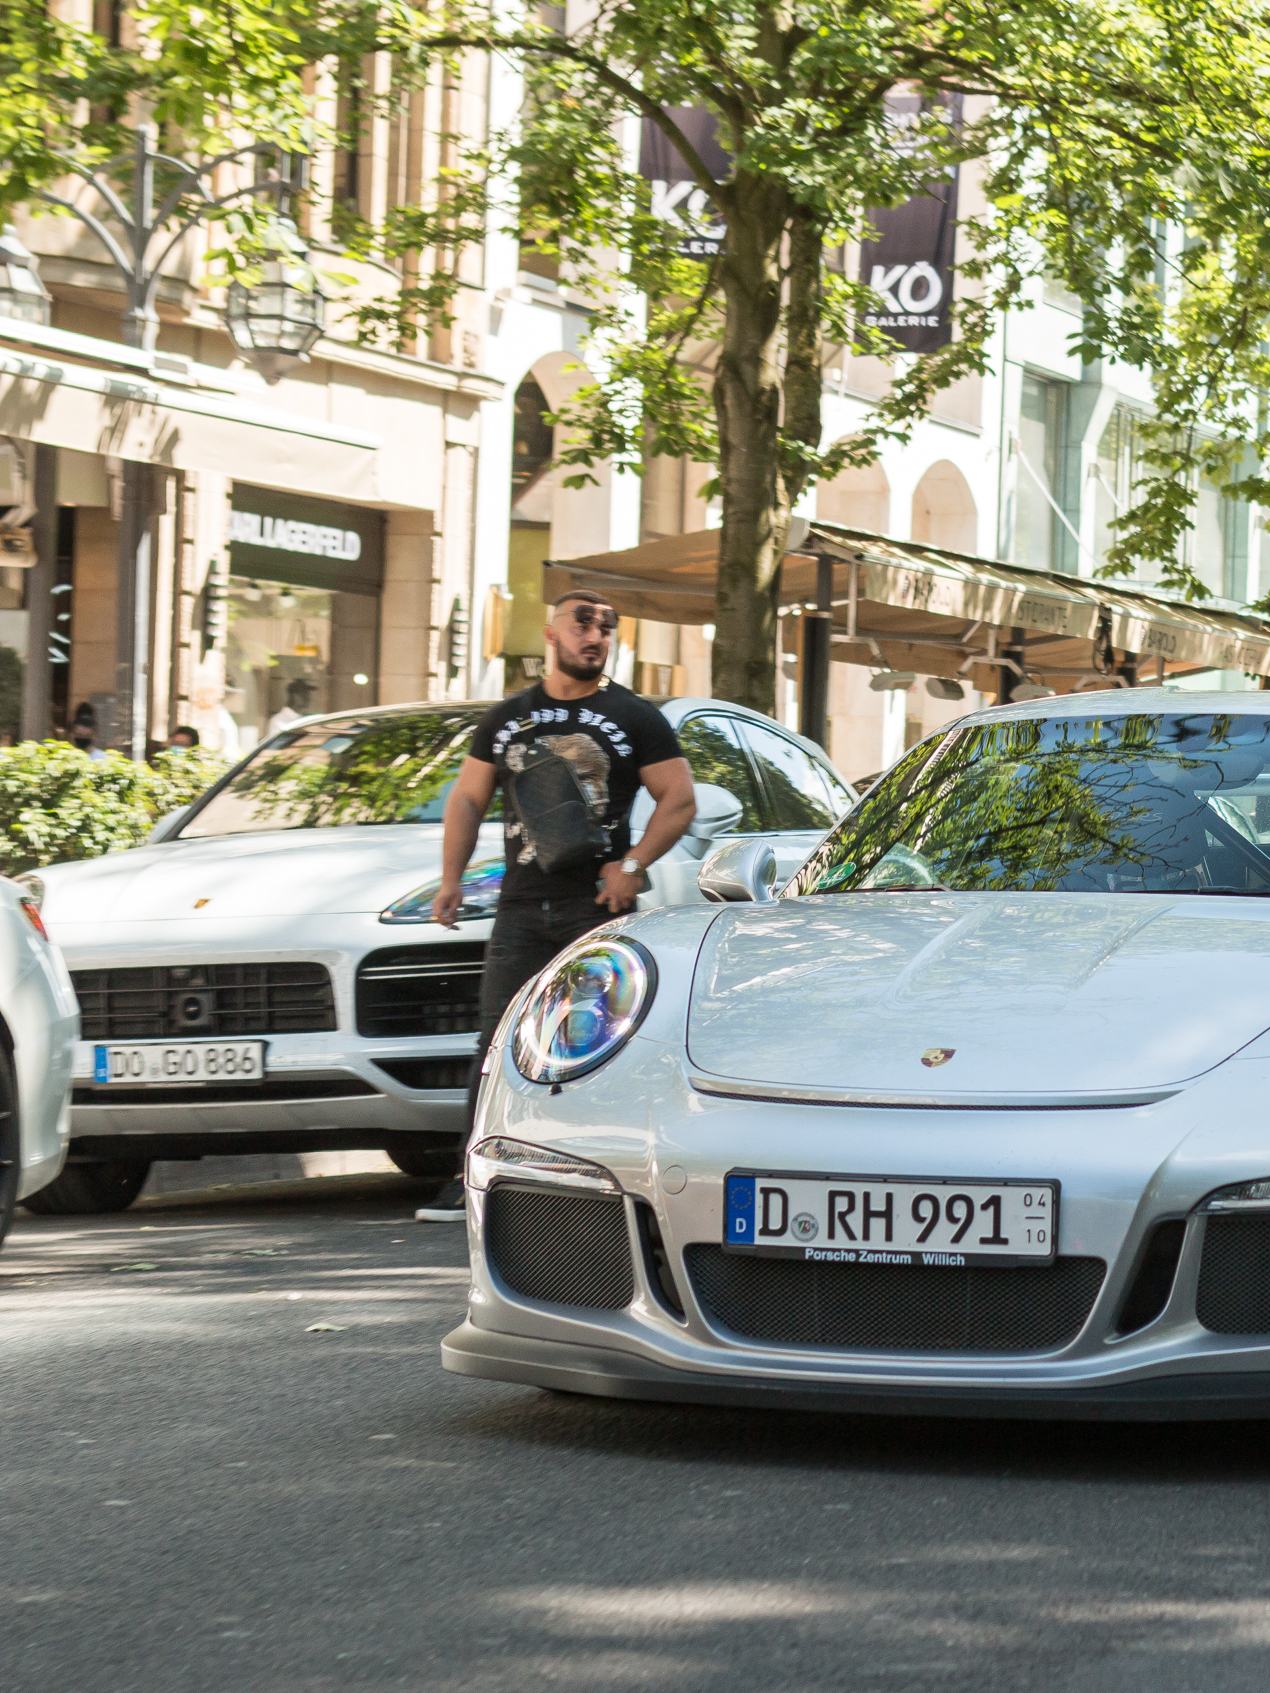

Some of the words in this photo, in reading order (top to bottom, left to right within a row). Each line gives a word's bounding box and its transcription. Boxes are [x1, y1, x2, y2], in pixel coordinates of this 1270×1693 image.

[865, 315, 939, 327] GALERIE
[110, 1051, 145, 1077] DO
[204, 1047, 255, 1075] 886
[1023, 1192, 1047, 1208] 04
[758, 1186, 790, 1237] D
[827, 1189, 894, 1243] RH
[911, 1193, 1009, 1245] 991
[735, 1217, 747, 1233] D
[1026, 1228, 1047, 1244] 10
[804, 1248, 856, 1262] Porsche
[858, 1250, 911, 1264] Zentrum
[922, 1252, 965, 1266] Willich
